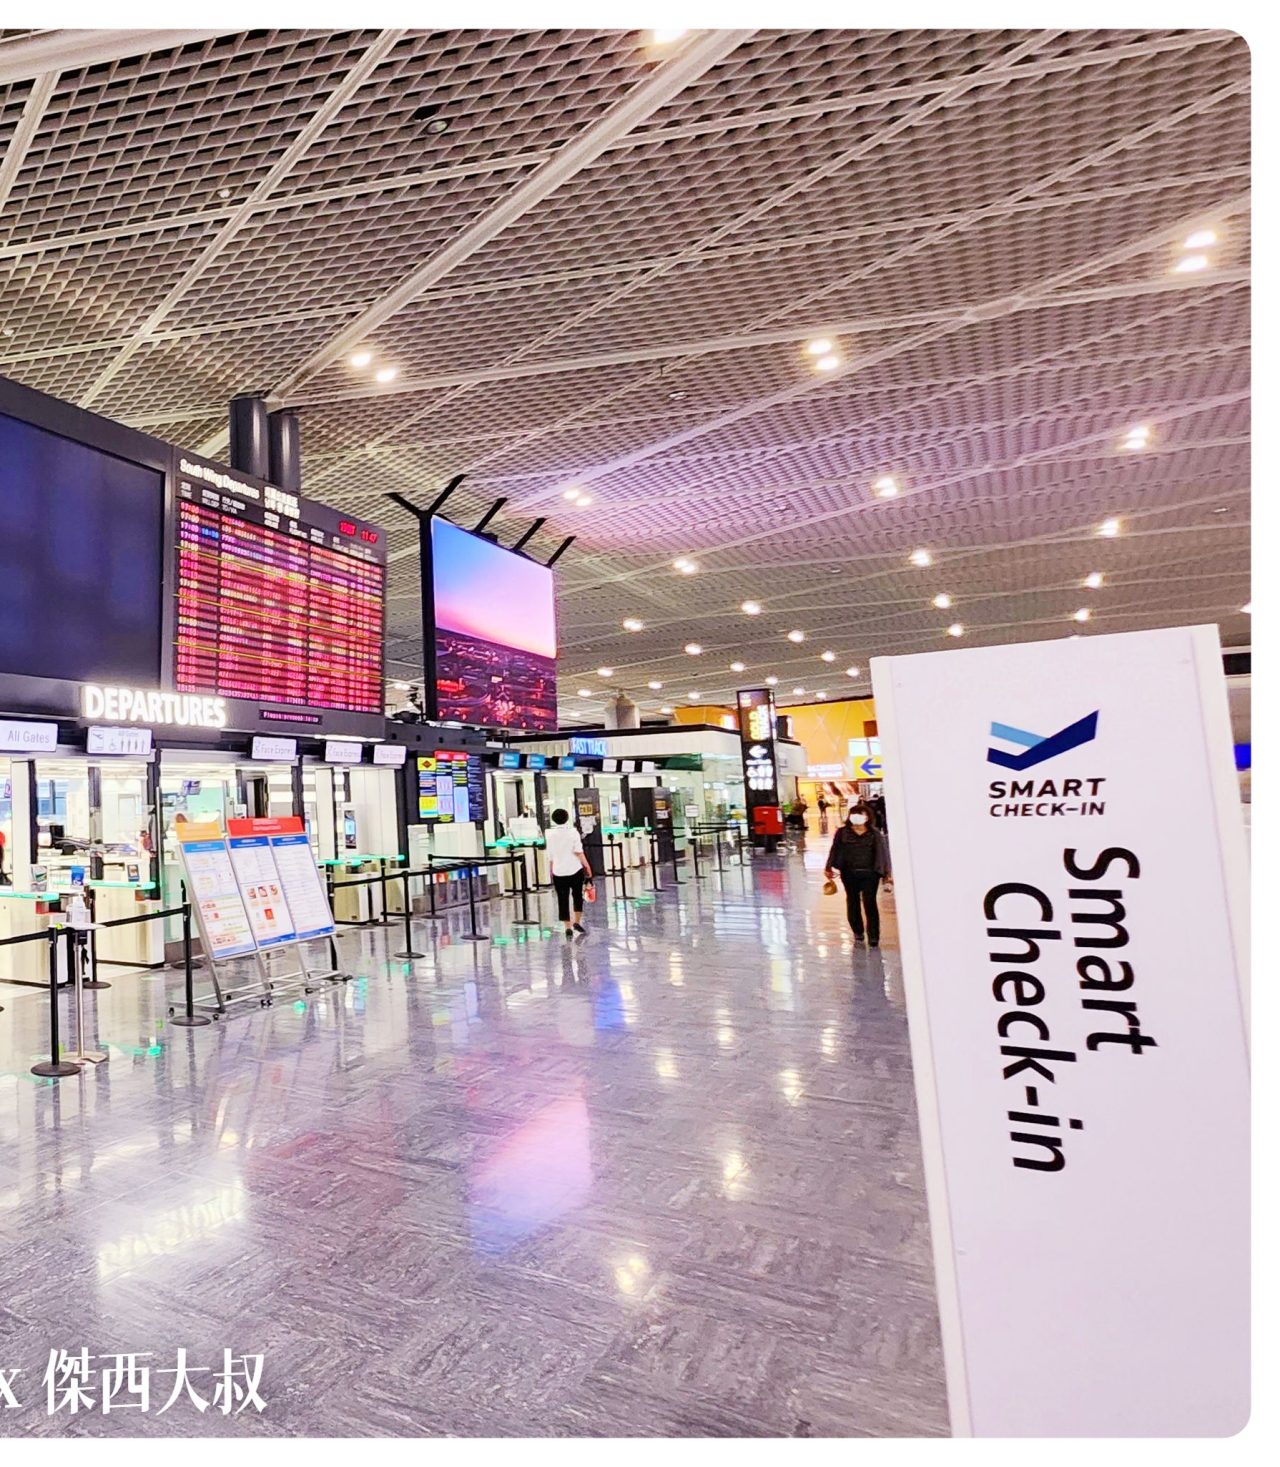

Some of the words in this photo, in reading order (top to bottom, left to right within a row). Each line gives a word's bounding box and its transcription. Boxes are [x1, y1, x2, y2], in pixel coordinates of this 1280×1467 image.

[83, 685, 227, 728] DEPARTURES
[7, 729, 21, 744] All
[23, 731, 50, 745] Gates
[986, 776, 1108, 800] SMART
[988, 800, 1108, 818] CHECK-IN
[1062, 845, 1160, 1056] Smart
[982, 881, 1084, 1174] Check-in
